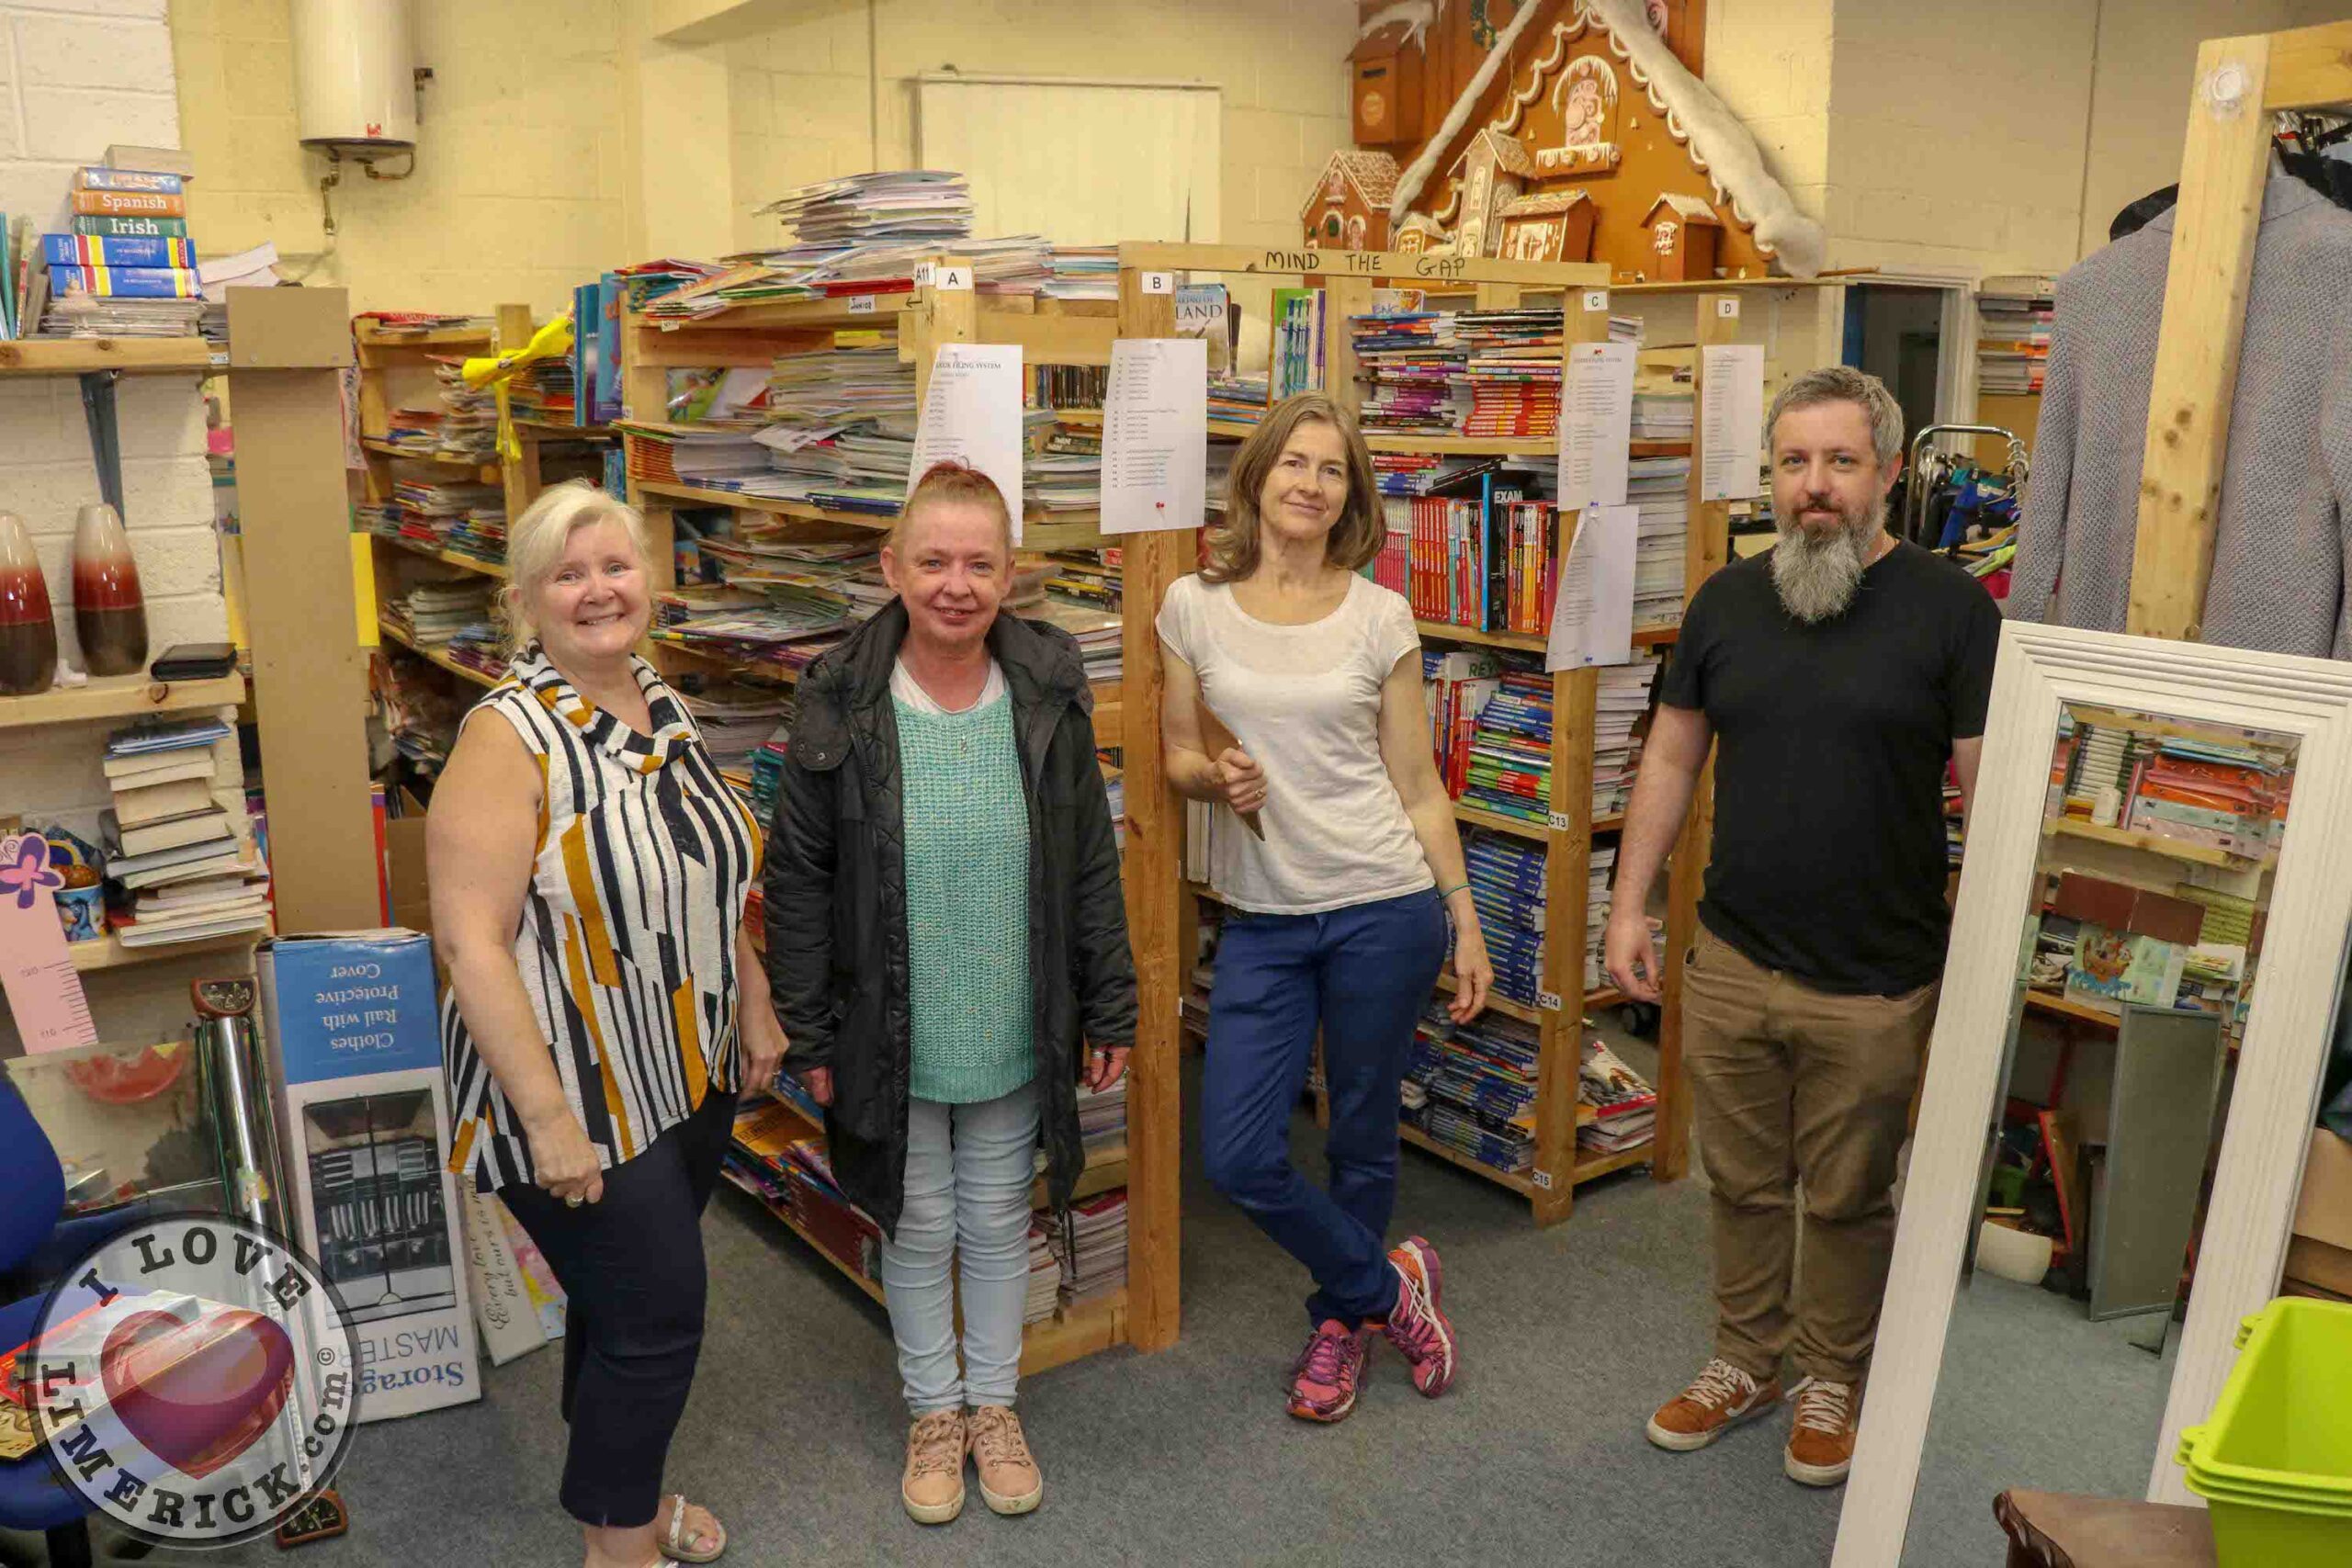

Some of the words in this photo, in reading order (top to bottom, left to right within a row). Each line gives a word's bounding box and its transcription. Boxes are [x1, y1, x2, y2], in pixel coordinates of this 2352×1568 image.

[102, 194, 167, 211] Spanish
[110, 218, 160, 235] Irish
[1265, 251, 1320, 271] MIND
[1345, 254, 1383, 272] THE
[1416, 256, 1466, 277] GAP
[915, 266, 930, 281] A11
[947, 272, 958, 285] A
[1152, 276, 1162, 289] B
[1591, 296, 1599, 308] C
[1724, 303, 1732, 314] D
[1175, 304, 1223, 321] LAND
[976, 361, 1001, 369] SYSTEM
[1494, 490, 1523, 504] EXAM
[1548, 815, 1566, 828] C13
[330, 963, 380, 979] Cover
[315, 985, 399, 1005] Protective
[1539, 994, 1558, 1008] C14
[322, 1013, 360, 1031] with
[364, 1010, 398, 1027] Rail
[330, 1032, 394, 1052] Clothes
[1532, 1171, 1550, 1185] C15
[488, 1229, 506, 1266] ours
[503, 1269, 519, 1297] but
[484, 1271, 510, 1330] Every
